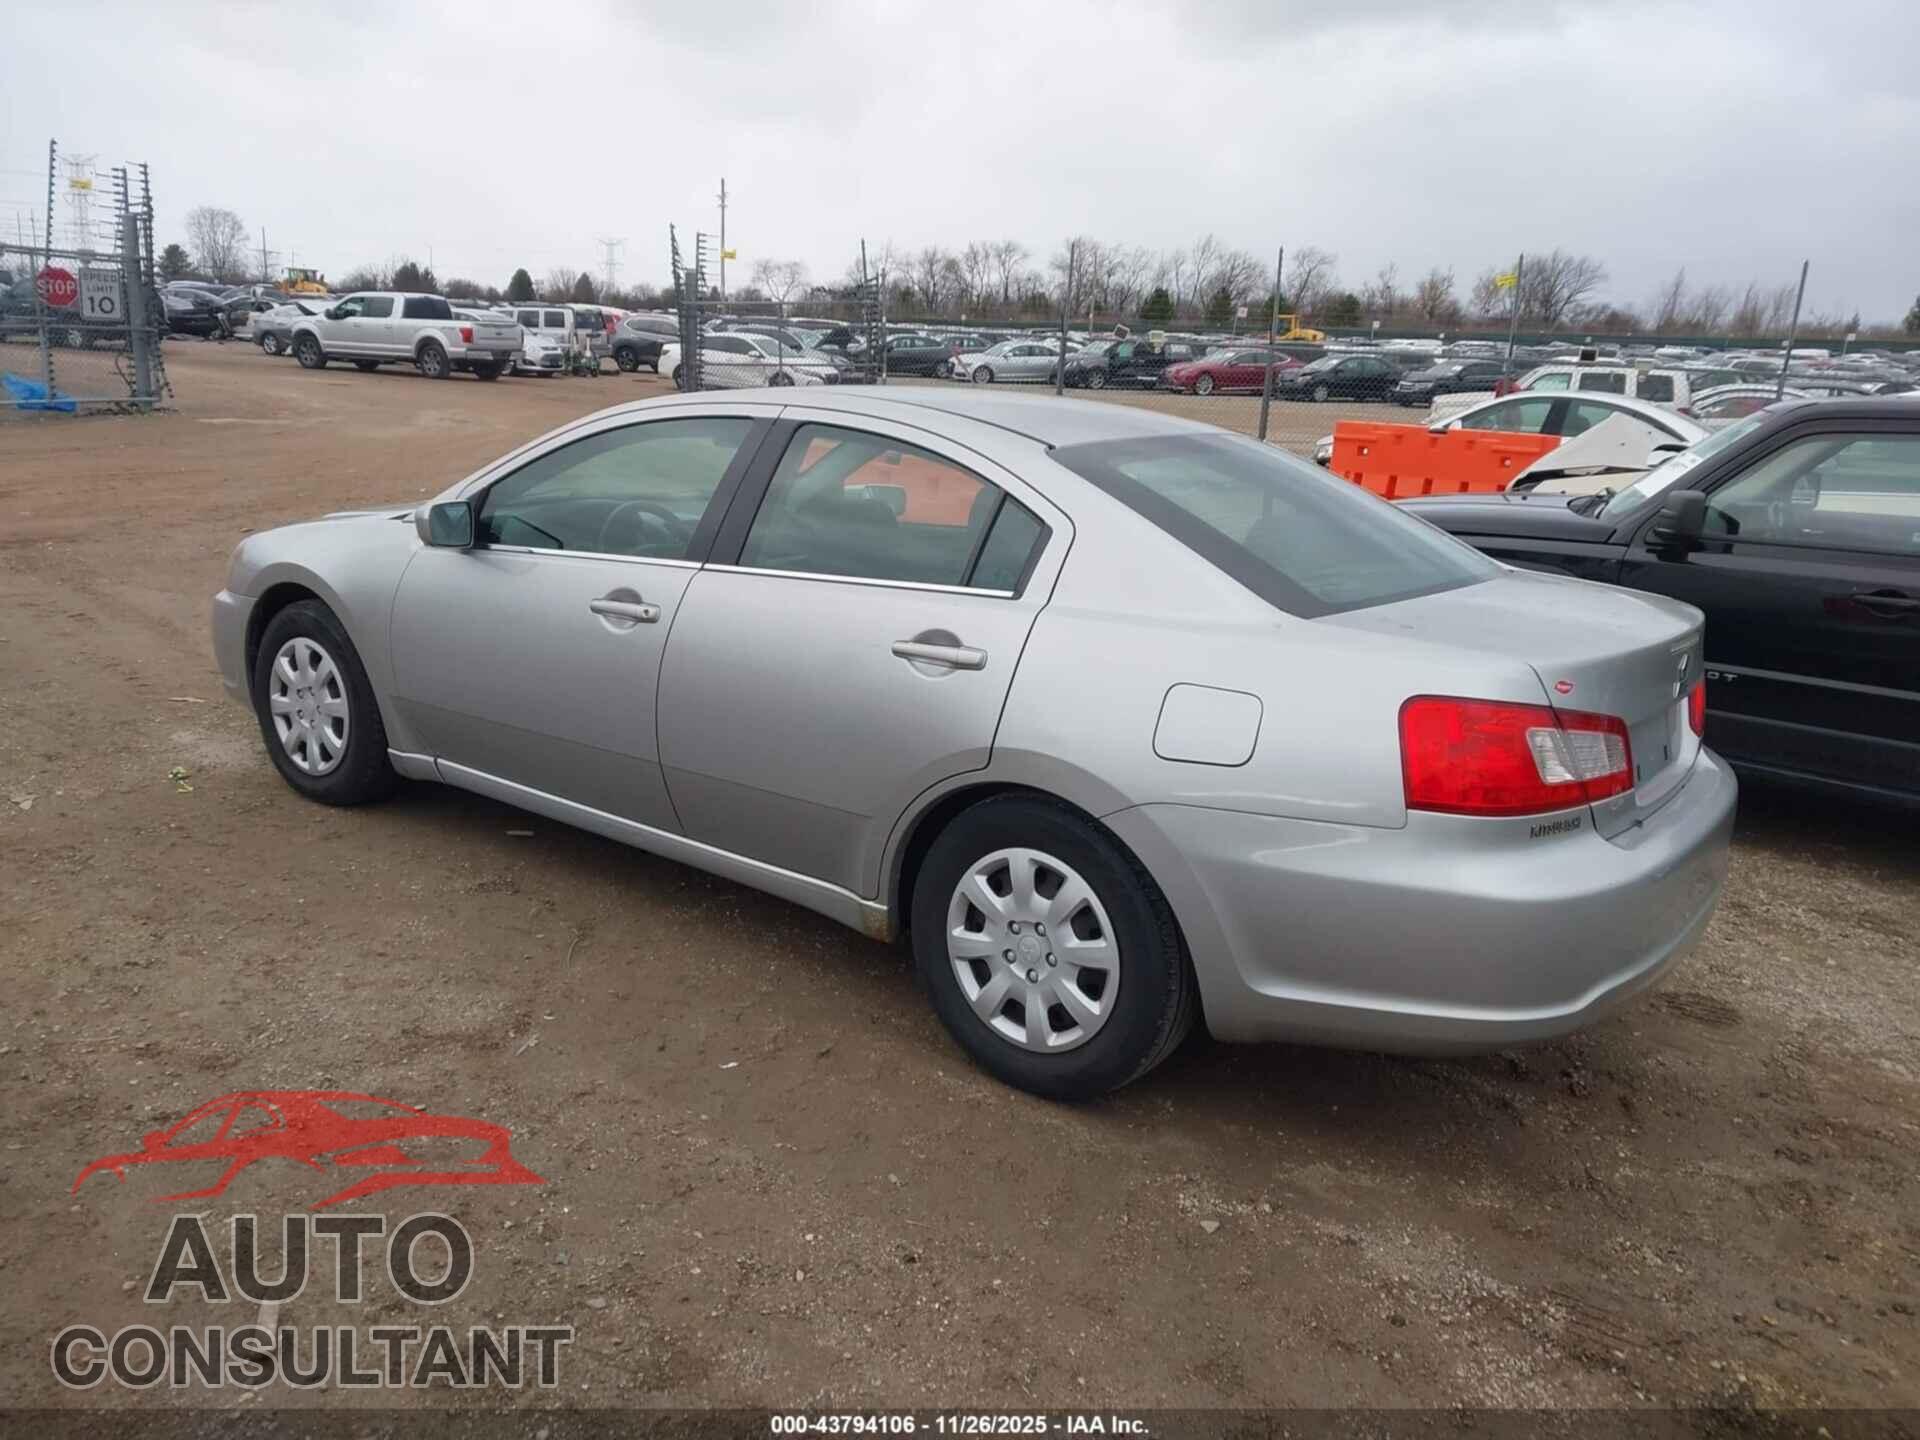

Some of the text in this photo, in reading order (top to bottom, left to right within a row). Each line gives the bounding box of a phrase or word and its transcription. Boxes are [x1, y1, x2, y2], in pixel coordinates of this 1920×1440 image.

[83, 271, 117, 282] SPEED
[36, 279, 76, 295] STOP
[87, 285, 113, 293] LIMIT
[87, 296, 115, 314] 10
